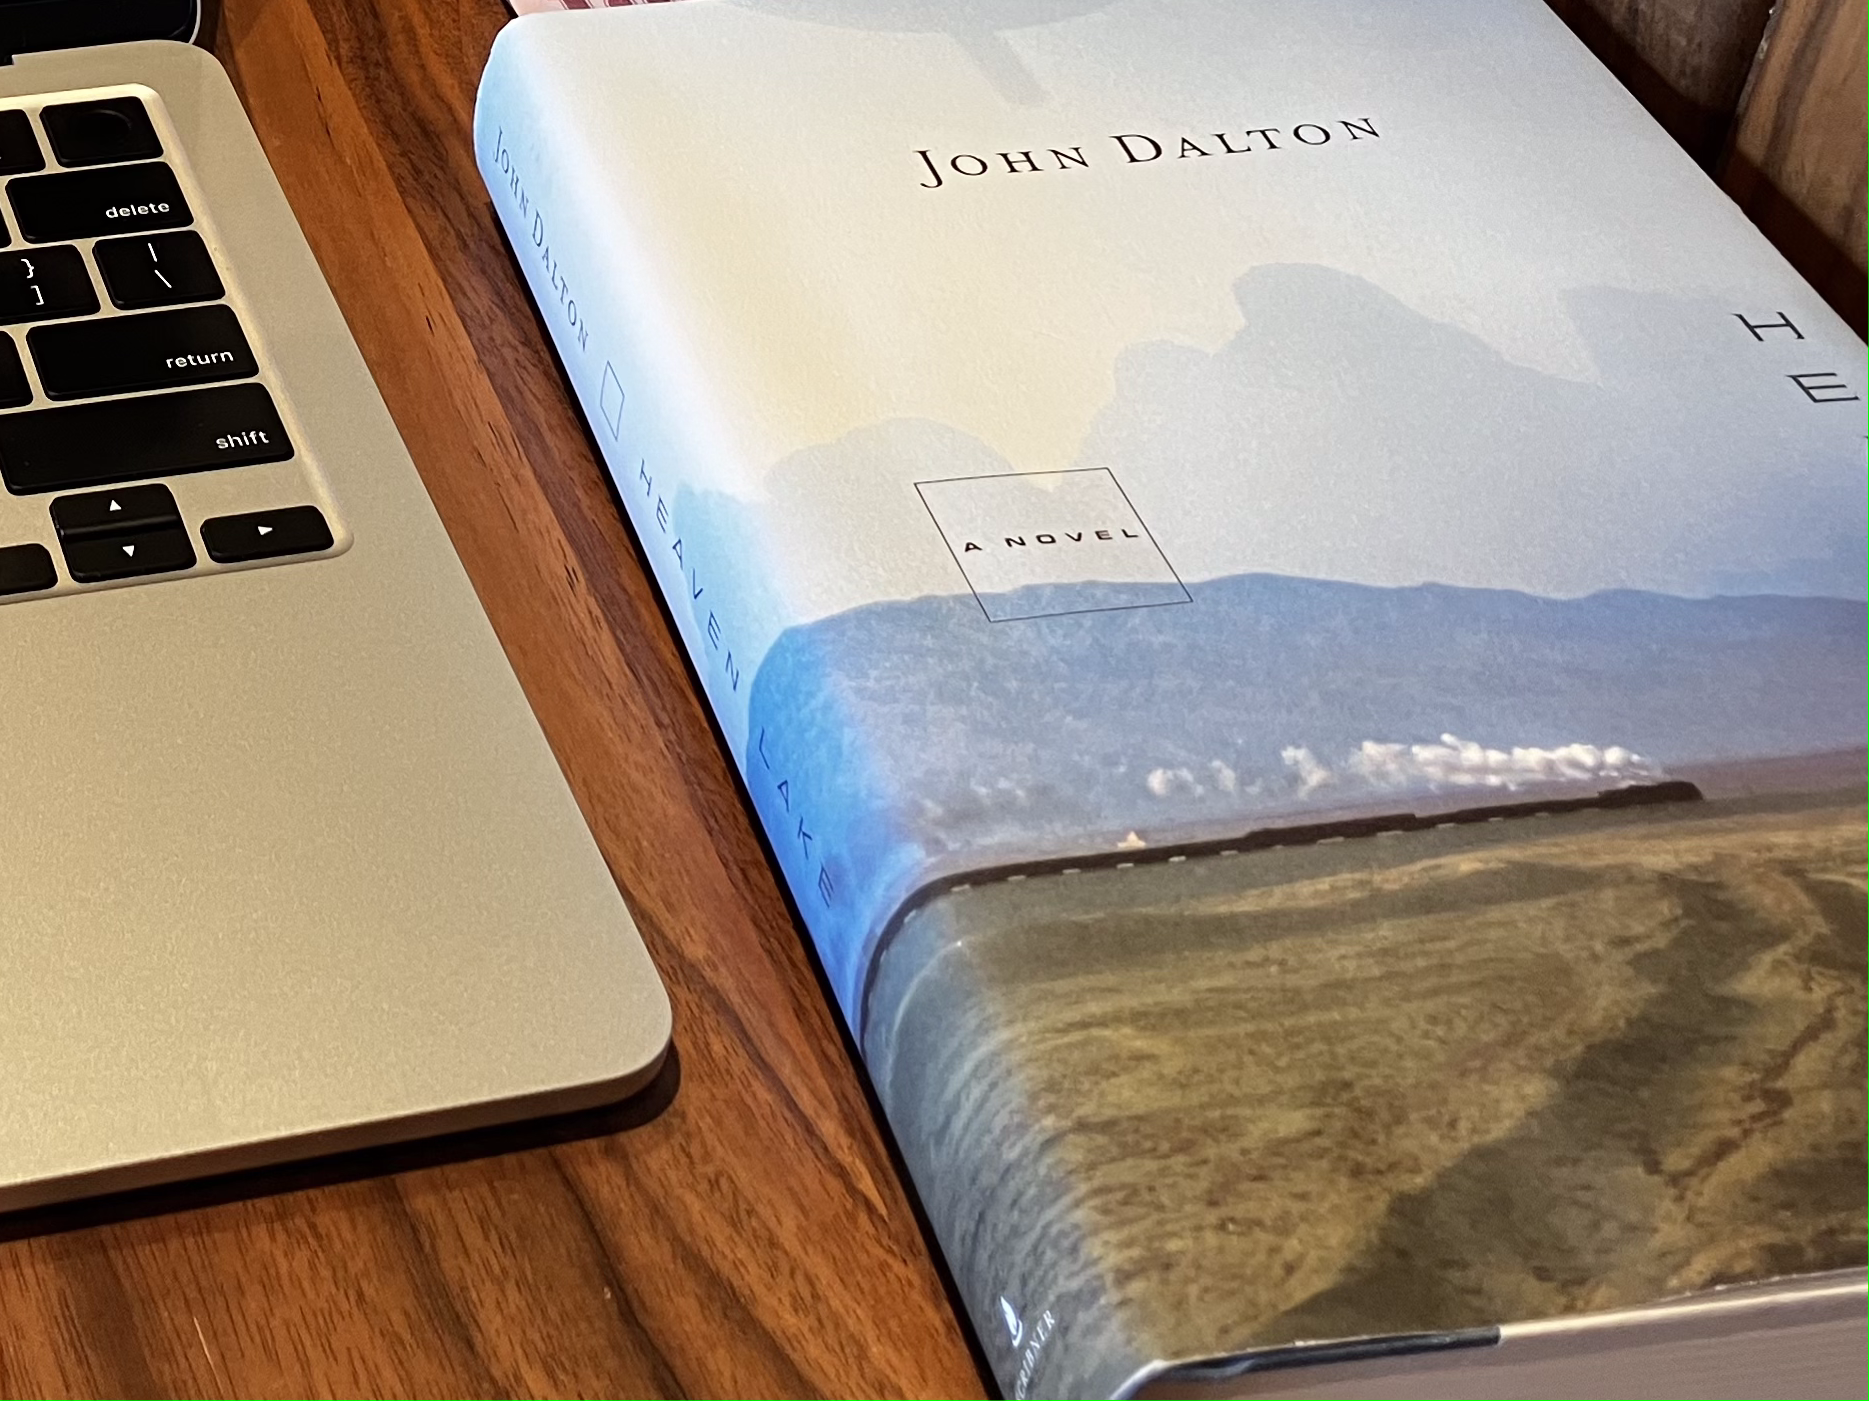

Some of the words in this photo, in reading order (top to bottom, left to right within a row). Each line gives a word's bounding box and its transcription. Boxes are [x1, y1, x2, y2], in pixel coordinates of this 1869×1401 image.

[914, 147, 1090, 189] JOHN
[1109, 118, 1381, 164] DALTON
[105, 200, 170, 219] delete
[493, 126, 530, 218] JOHN
[531, 208, 589, 353] DALTON
[165, 349, 234, 369] return
[215, 429, 269, 450] shift
[964, 542, 982, 552] A
[1005, 529, 1138, 547] NOVEL
[638, 458, 740, 693] HEAVEN
[758, 729, 835, 908] LAKE
[1014, 1309, 1055, 1401] CRIBNER
